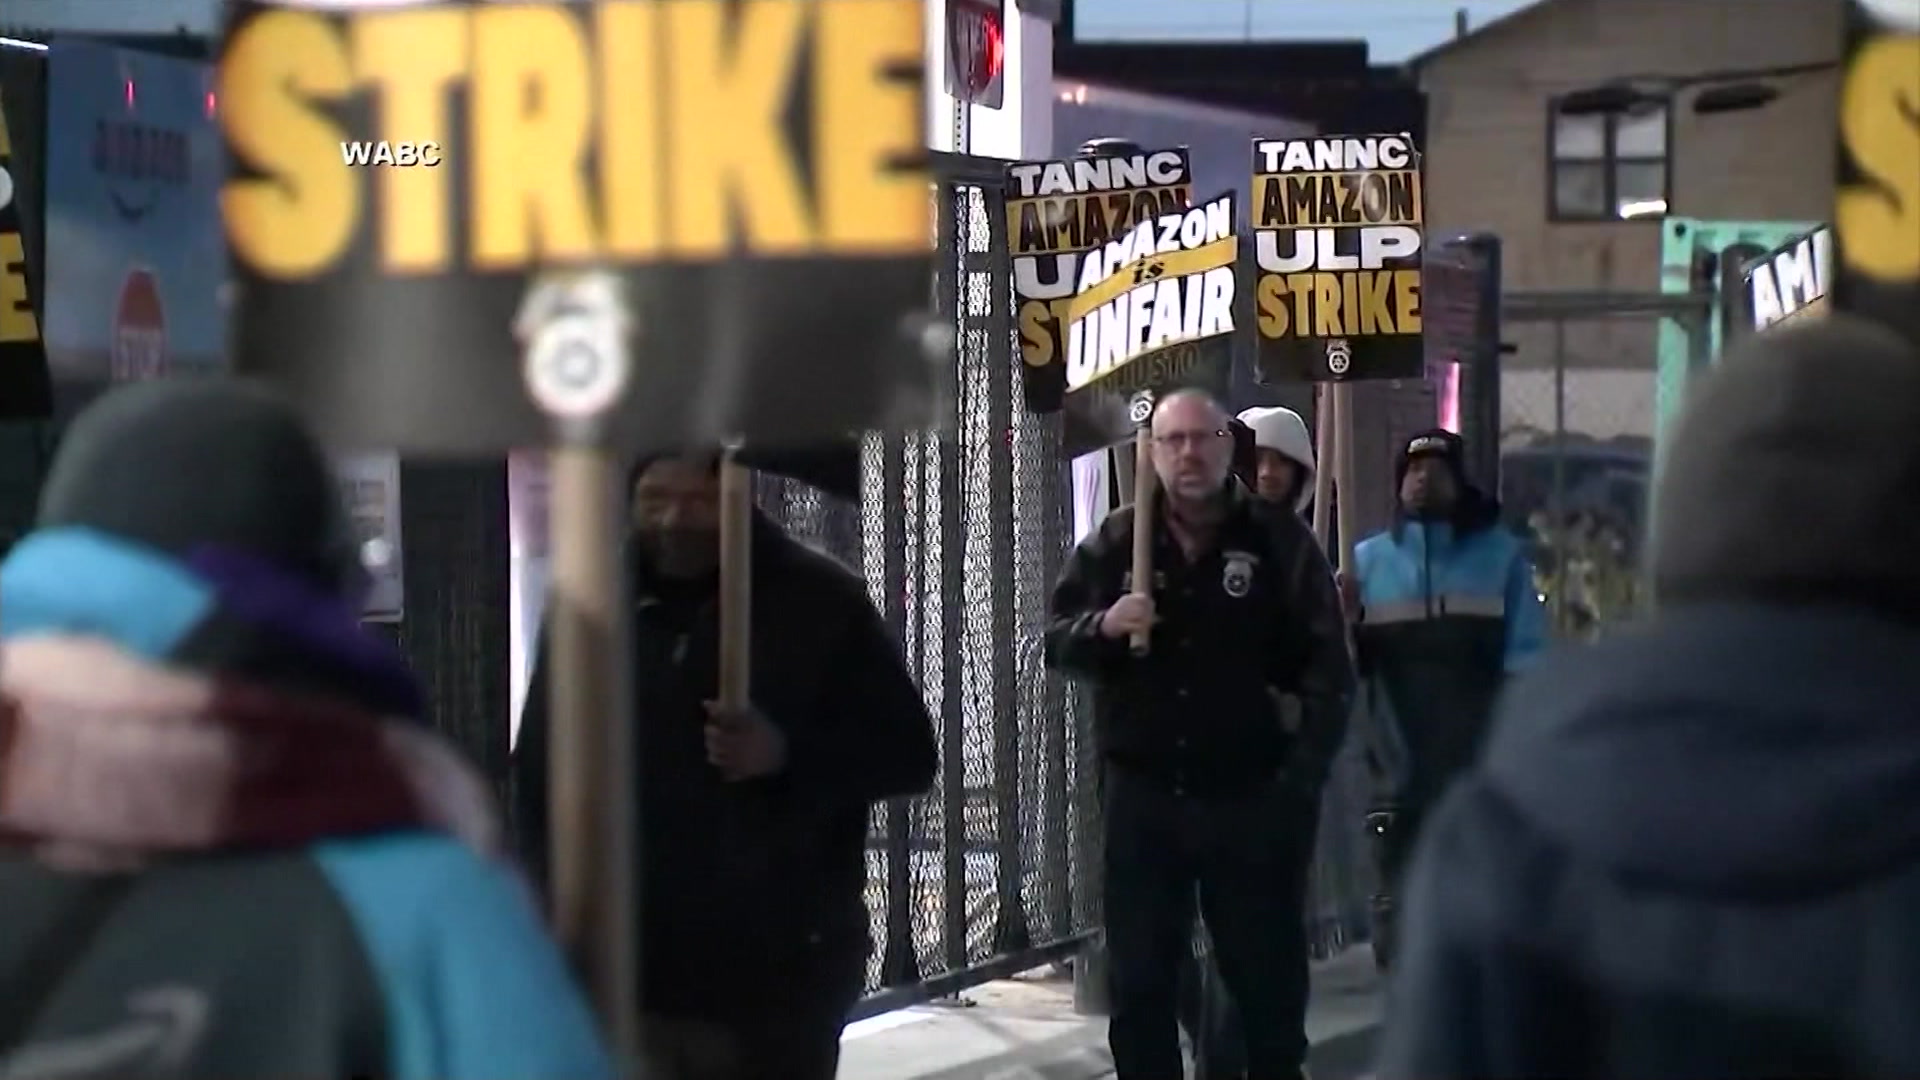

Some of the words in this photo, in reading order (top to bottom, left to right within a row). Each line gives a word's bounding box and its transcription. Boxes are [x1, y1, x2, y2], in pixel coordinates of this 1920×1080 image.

[219, 2, 931, 276] STRIKE
[1259, 136, 1410, 173] TANNC
[1011, 151, 1184, 198] TANNC
[1261, 172, 1415, 226] AMAZON
[1077, 197, 1231, 294] AMAZON
[1132, 254, 1165, 285] is
[1256, 225, 1421, 273] ULP
[1066, 265, 1236, 391] UNFAIR
[1258, 270, 1423, 340] STRIKE
